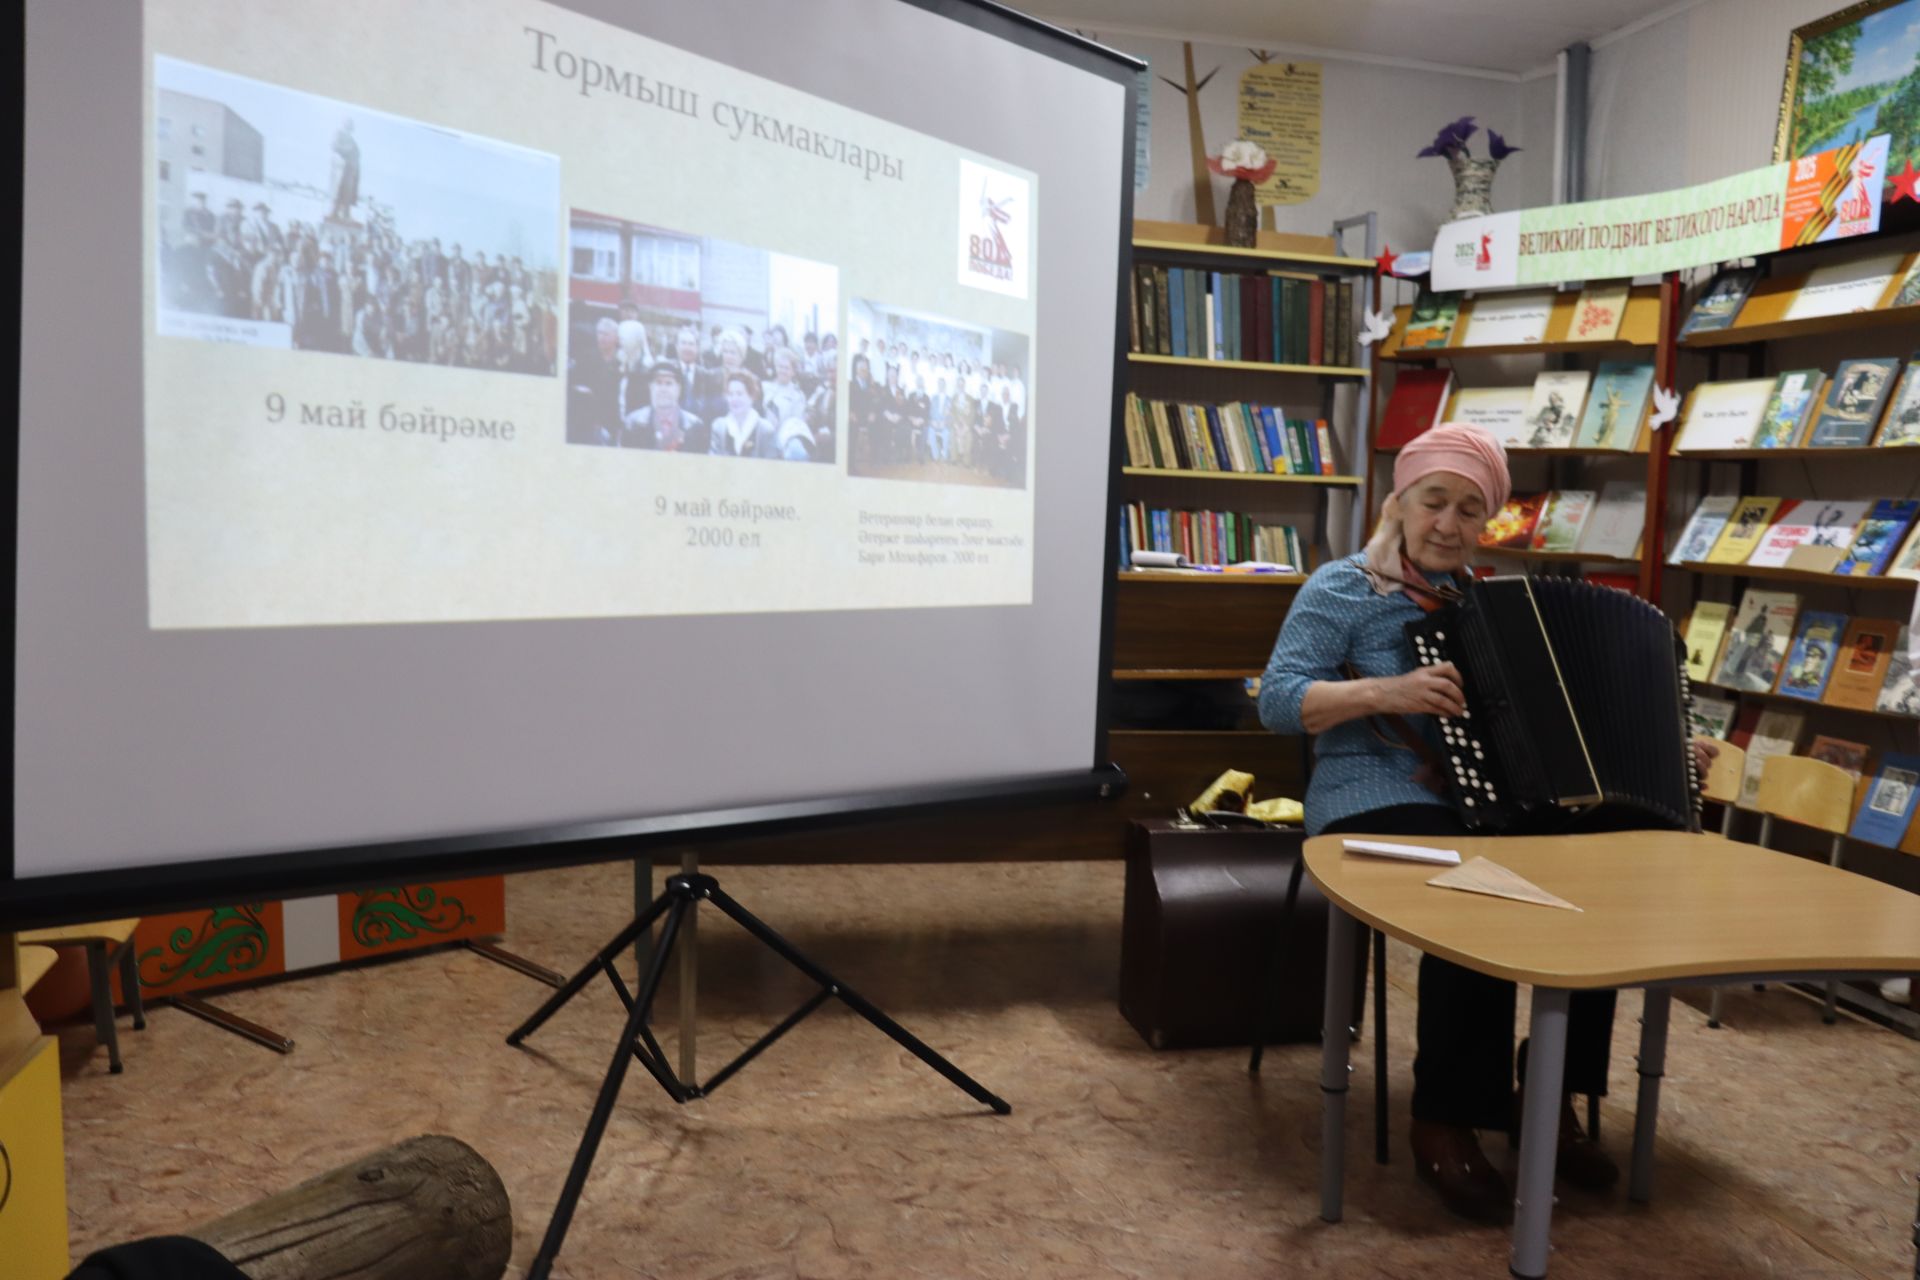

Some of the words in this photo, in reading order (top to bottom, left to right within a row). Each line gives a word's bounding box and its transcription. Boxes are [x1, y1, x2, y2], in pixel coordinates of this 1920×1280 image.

[523, 25, 700, 118] Тормыш
[711, 100, 904, 181] сукмаклары
[1795, 154, 1817, 181] 2025
[1519, 222, 1586, 256] ВЕЛИКИЙ
[1589, 220, 1653, 252] ПОДВИГ
[1655, 205, 1725, 244] ВЕЛИКОГО
[1726, 193, 1780, 229] НАРОДА
[970, 233, 993, 261] 80
[1455, 242, 1475, 258] 2025
[265, 392, 286, 424] 9
[299, 400, 367, 430] май
[378, 402, 516, 442] бәйрәме
[654, 494, 667, 517] 9
[674, 498, 712, 518] май
[687, 525, 734, 547] 2000
[738, 531, 761, 548] ел
